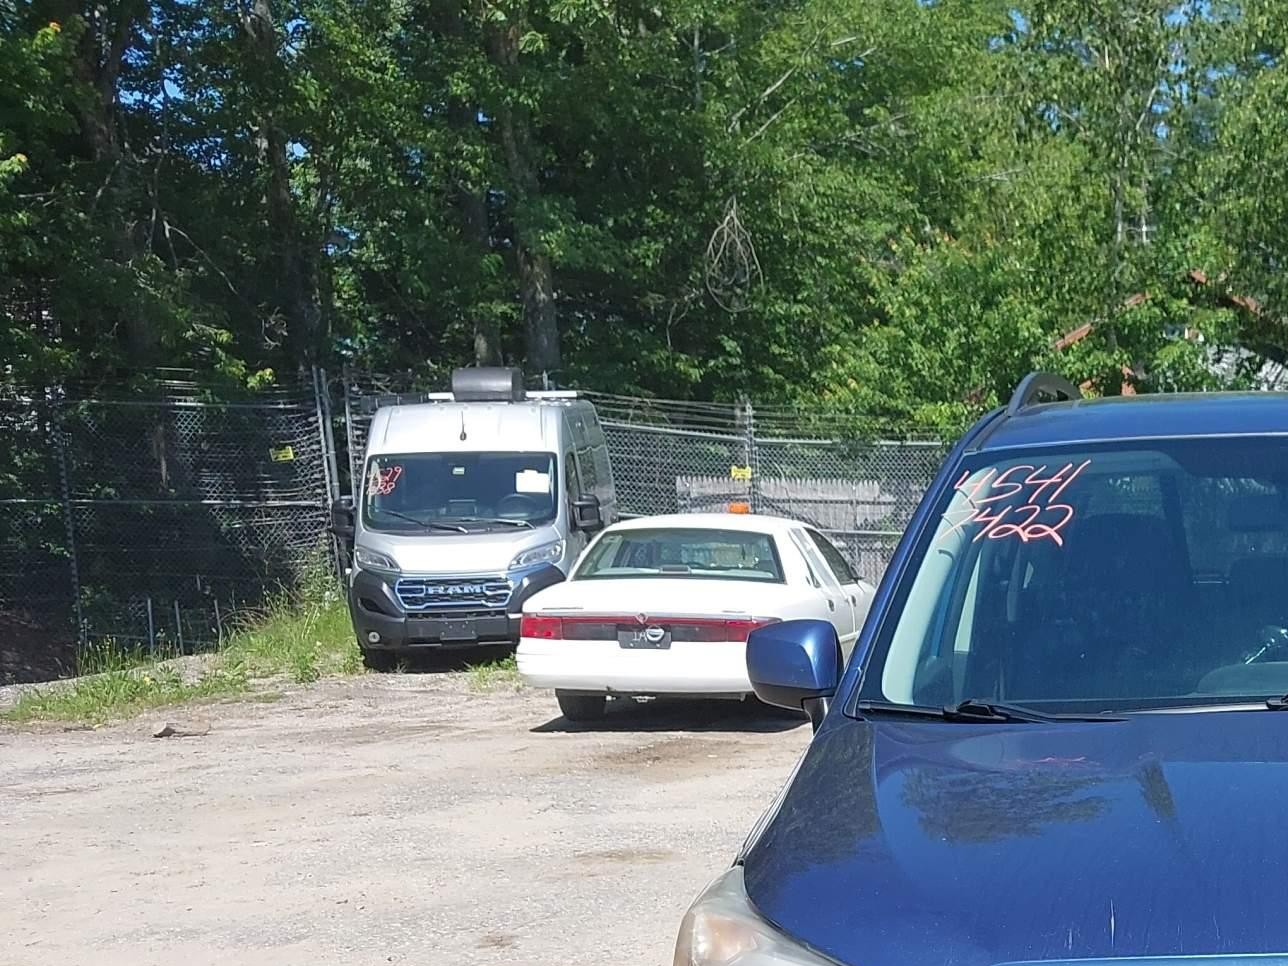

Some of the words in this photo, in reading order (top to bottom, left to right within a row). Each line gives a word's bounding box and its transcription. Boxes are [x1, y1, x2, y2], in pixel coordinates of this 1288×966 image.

[954, 459, 1091, 504] 4541
[940, 504, 1073, 546] 7422
[427, 584, 480, 595] RAM
